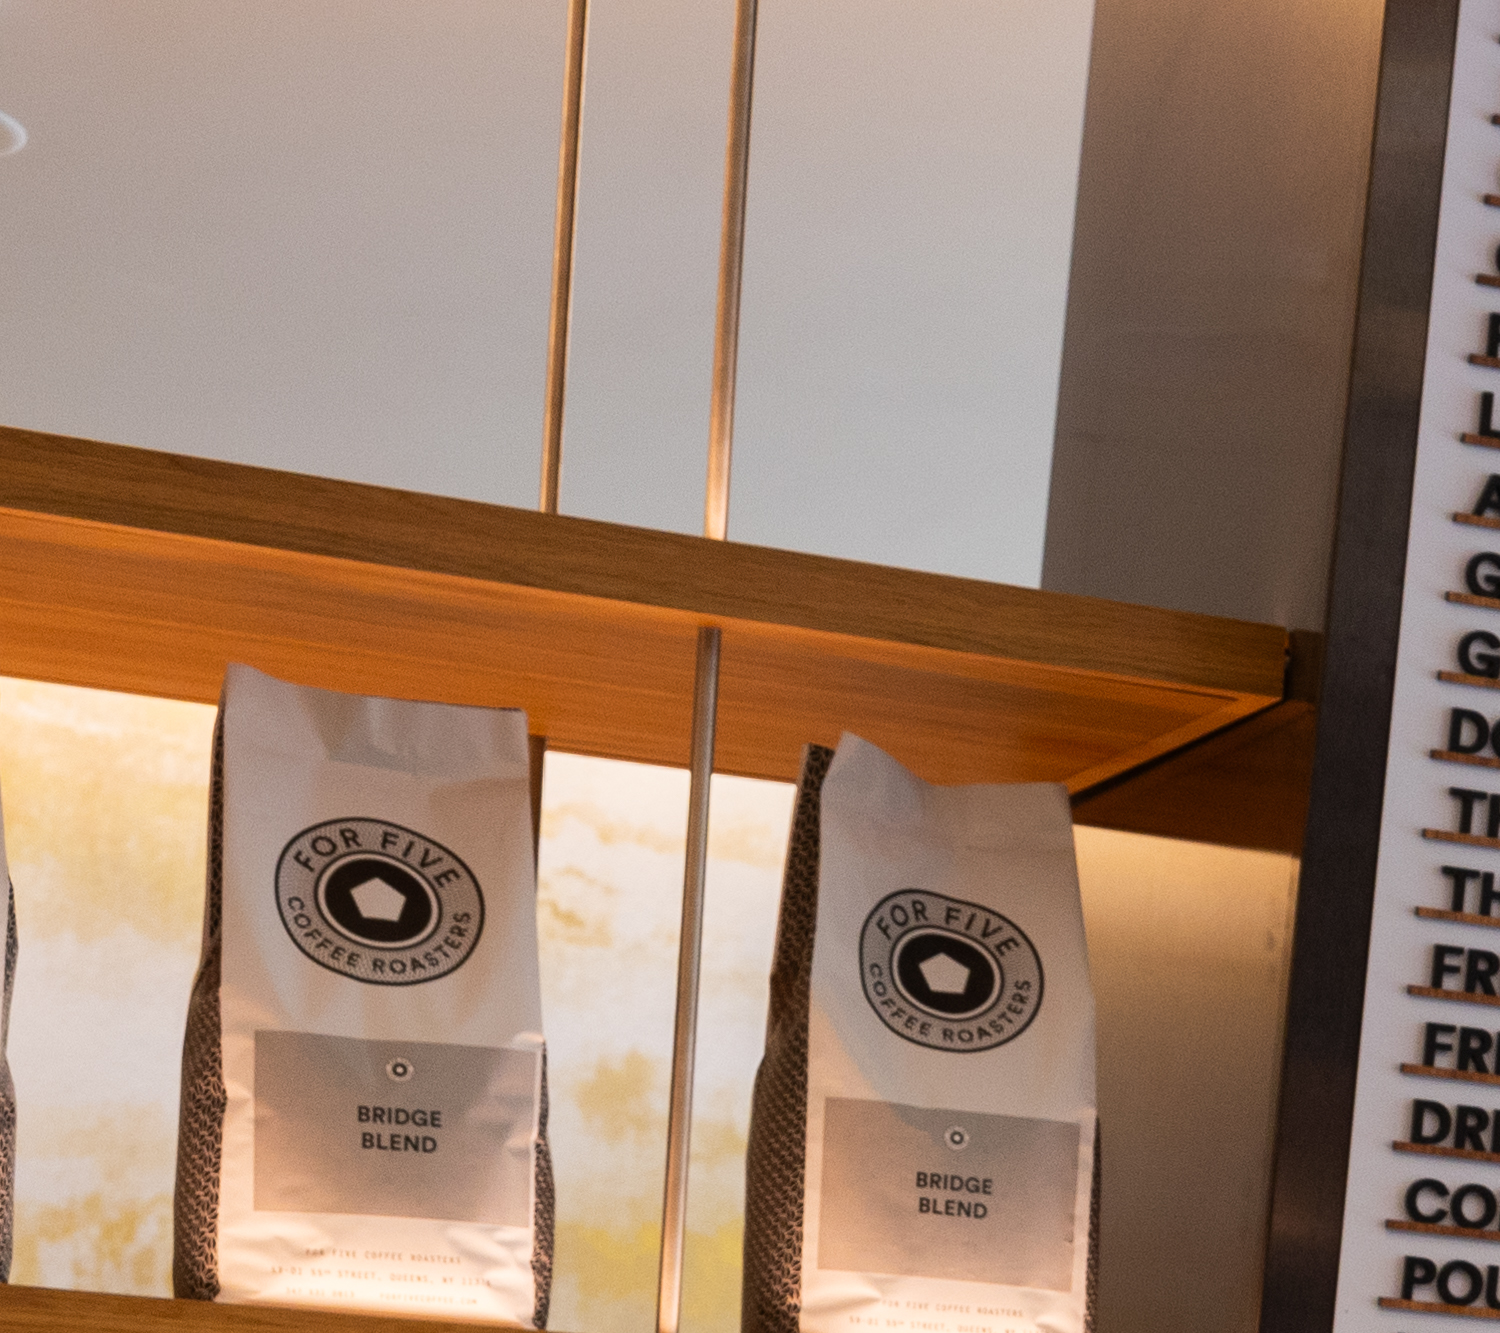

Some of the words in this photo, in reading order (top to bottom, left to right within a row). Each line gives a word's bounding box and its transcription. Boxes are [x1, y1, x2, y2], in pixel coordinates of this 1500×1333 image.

[294, 828, 362, 872] FOR
[380, 831, 461, 888] FIVE
[287, 896, 361, 967] COFFEE
[372, 911, 471, 974] ROASTERS
[357, 1105, 442, 1128] BRIDGE
[361, 1132, 438, 1154] BLEND
[916, 1171, 993, 1195] BRIDGE
[919, 1197, 988, 1219] BLEND
